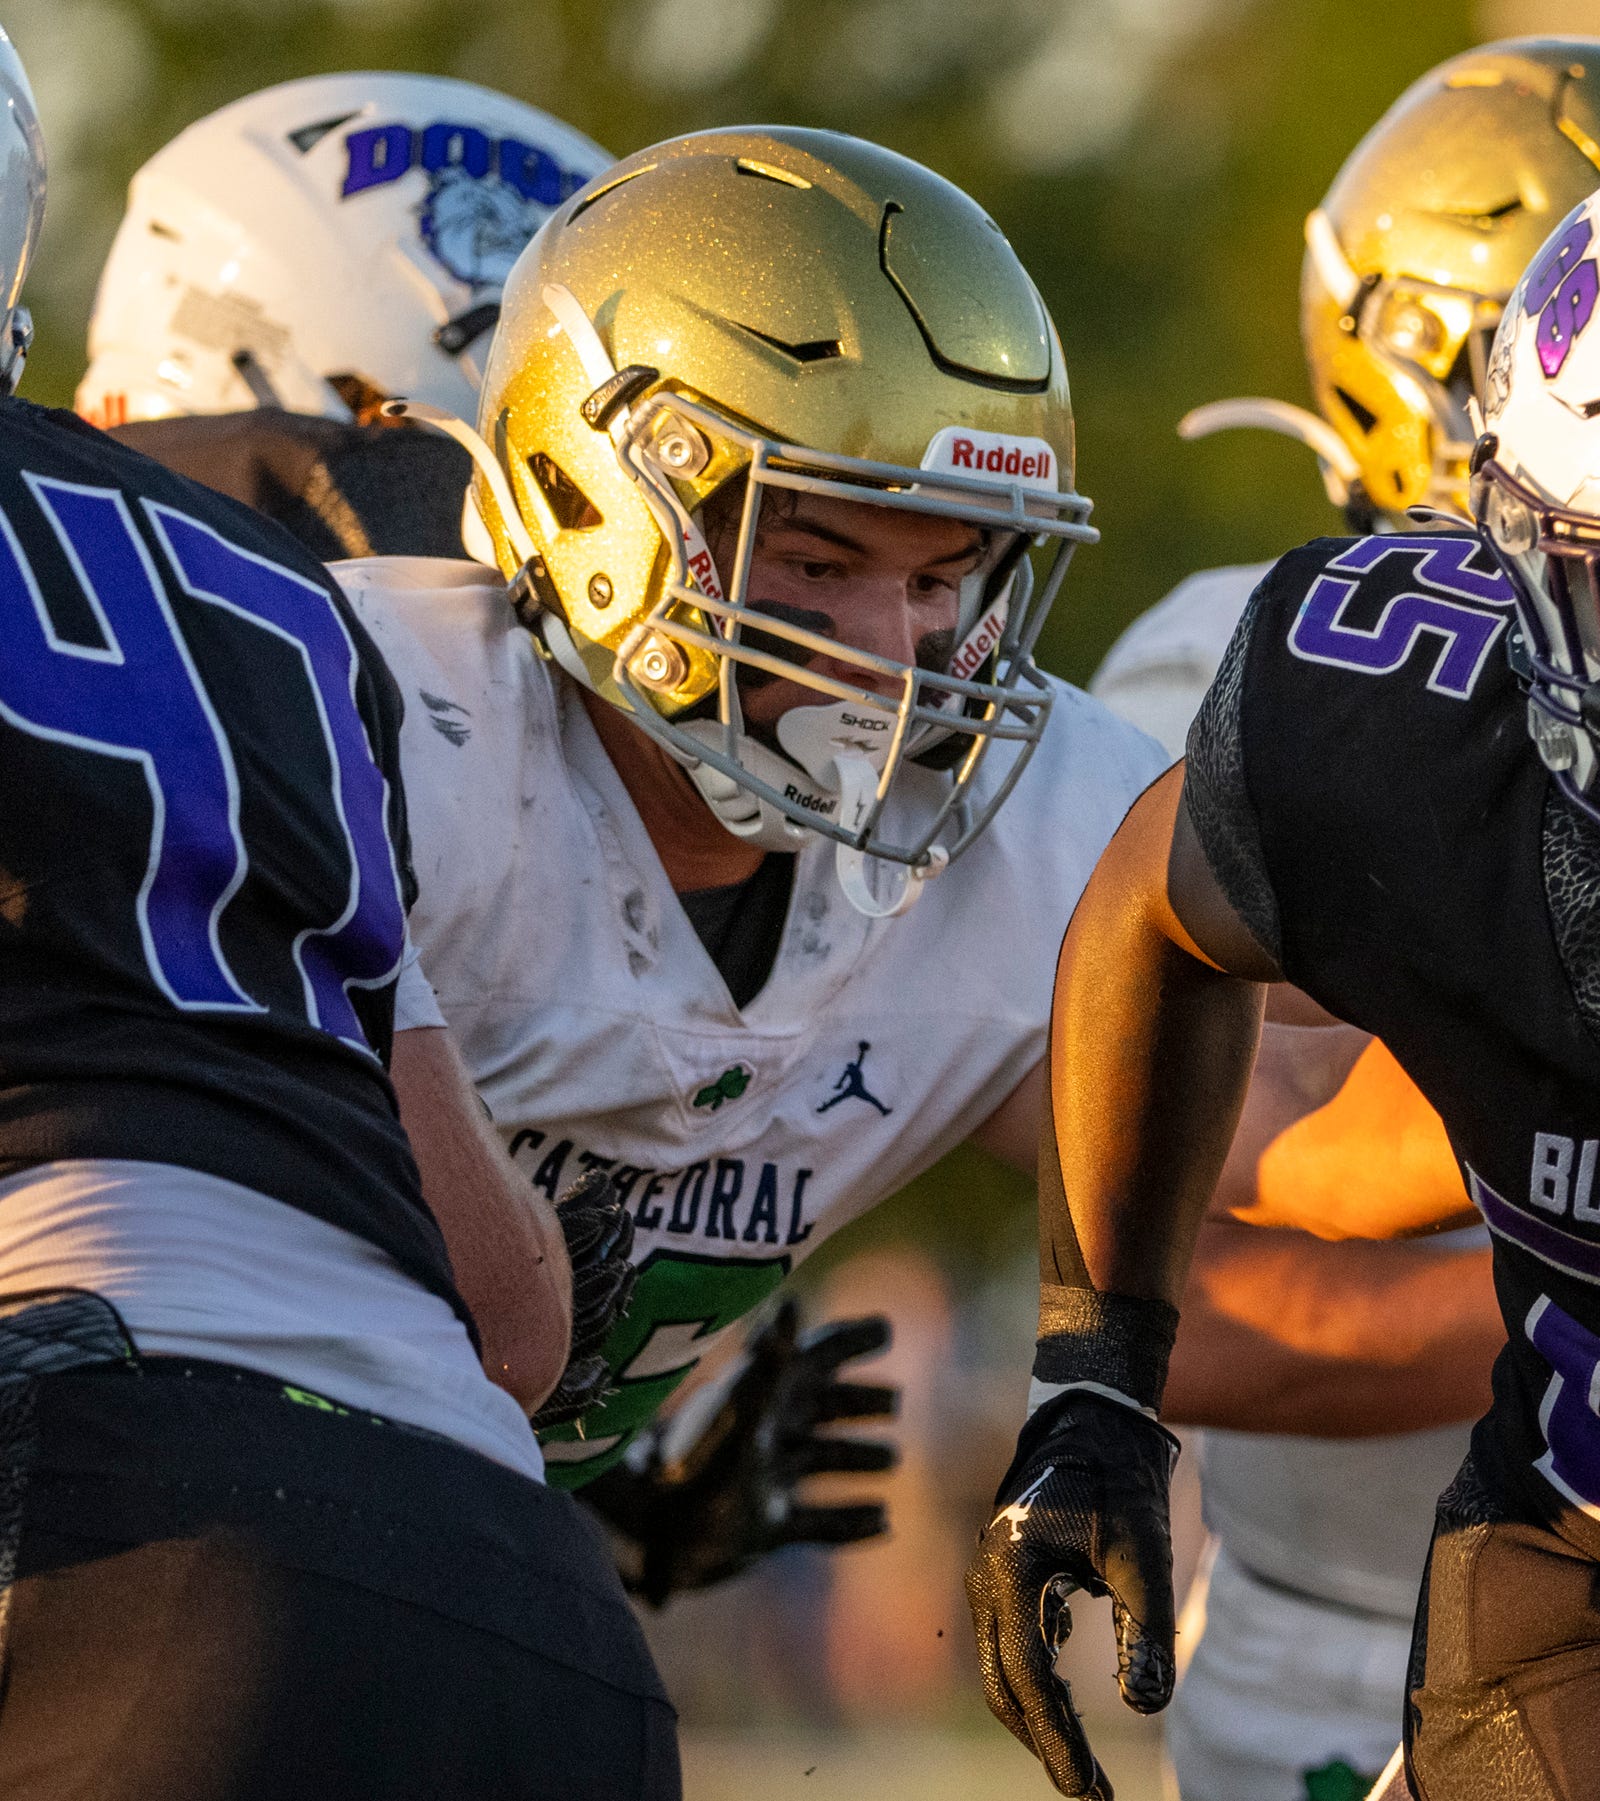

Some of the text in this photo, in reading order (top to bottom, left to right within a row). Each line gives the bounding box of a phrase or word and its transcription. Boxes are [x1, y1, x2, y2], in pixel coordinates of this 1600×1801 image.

[341, 122, 590, 206] DOG
[952, 437, 1051, 479] Riddell
[931, 613, 1005, 698] ddell
[1286, 534, 1518, 700] 25
[0, 470, 408, 1068] 47
[783, 783, 838, 815] Riddell
[507, 1128, 816, 1245] CAEDRAL
